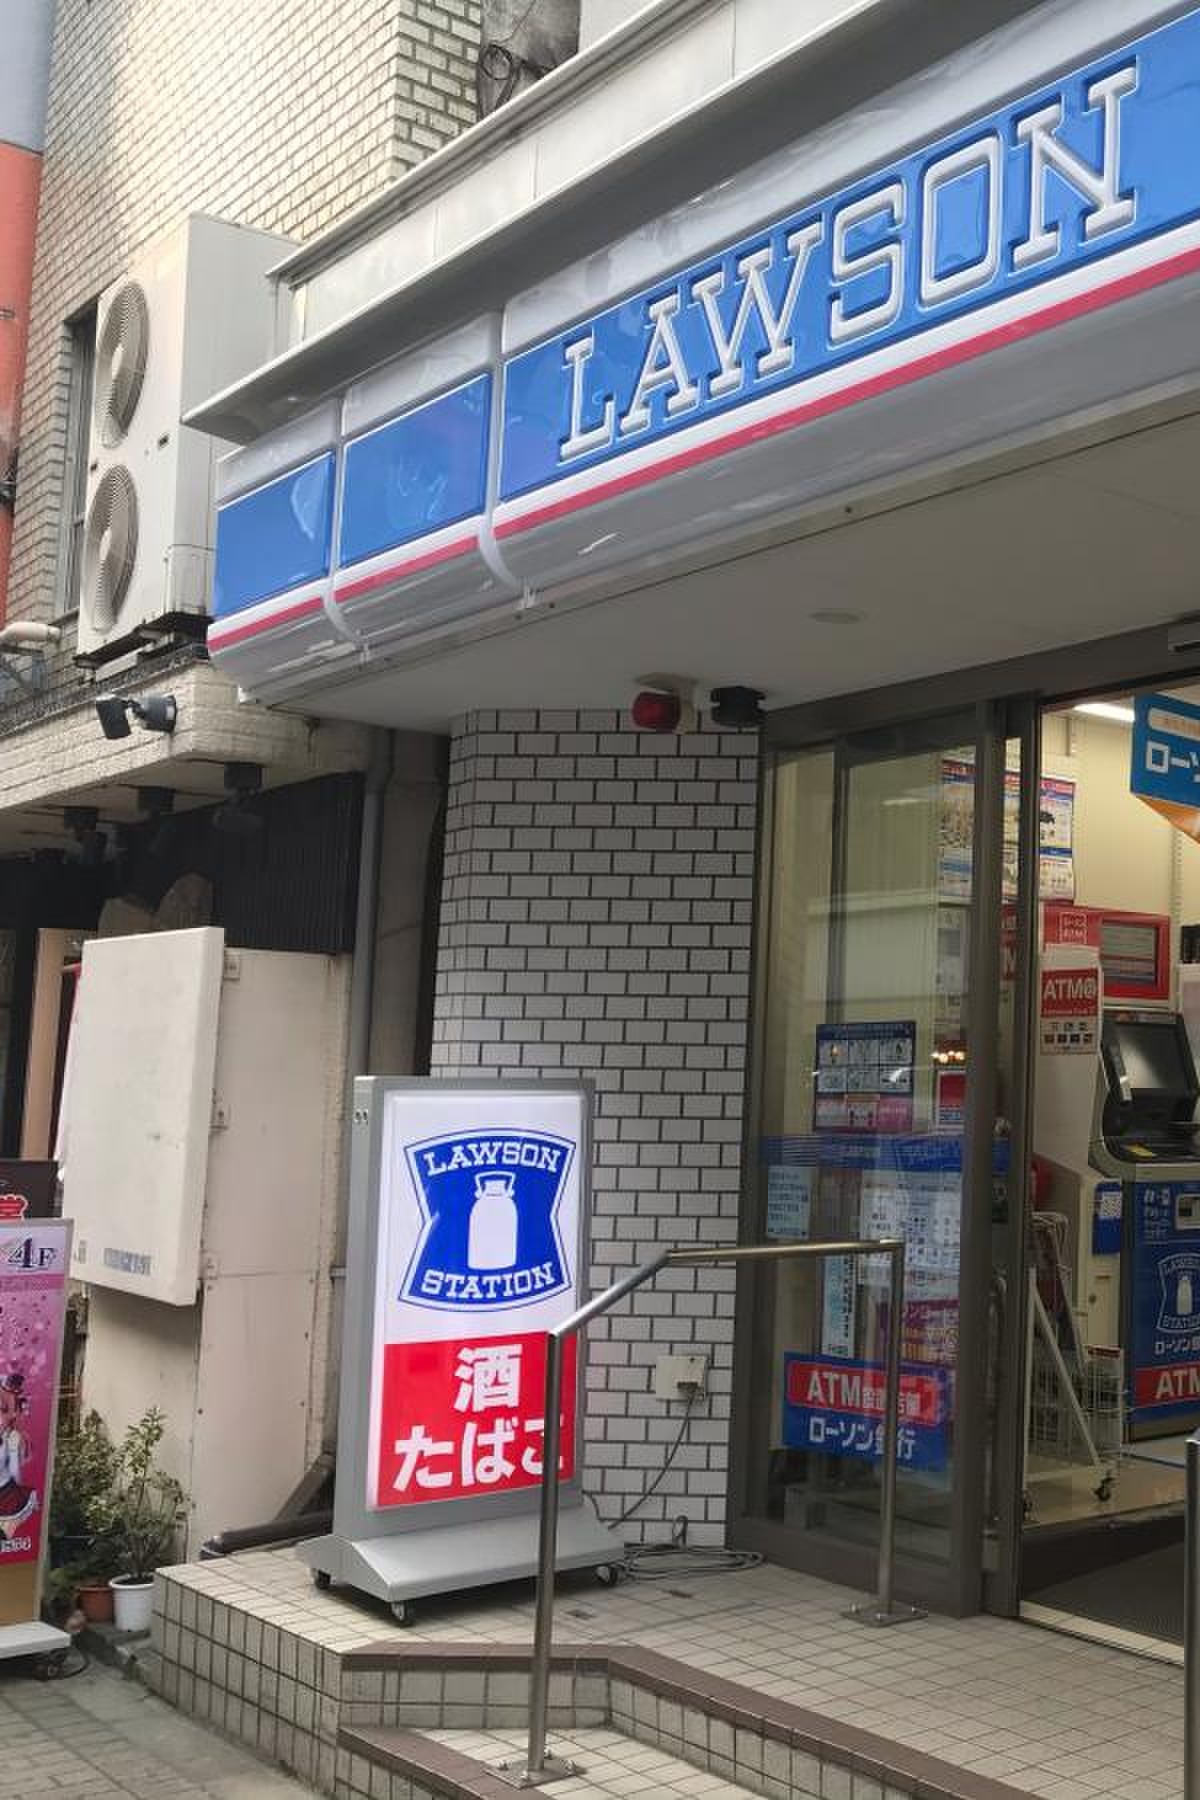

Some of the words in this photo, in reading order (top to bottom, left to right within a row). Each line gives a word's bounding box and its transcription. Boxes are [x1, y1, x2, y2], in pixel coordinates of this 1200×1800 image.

[559, 62, 1137, 463] LAWSON
[423, 1140, 561, 1176] LAWSON
[421, 1262, 556, 1300] STATION
[453, 1344, 523, 1413] 酒
[393, 1416, 566, 1492] たばこ
